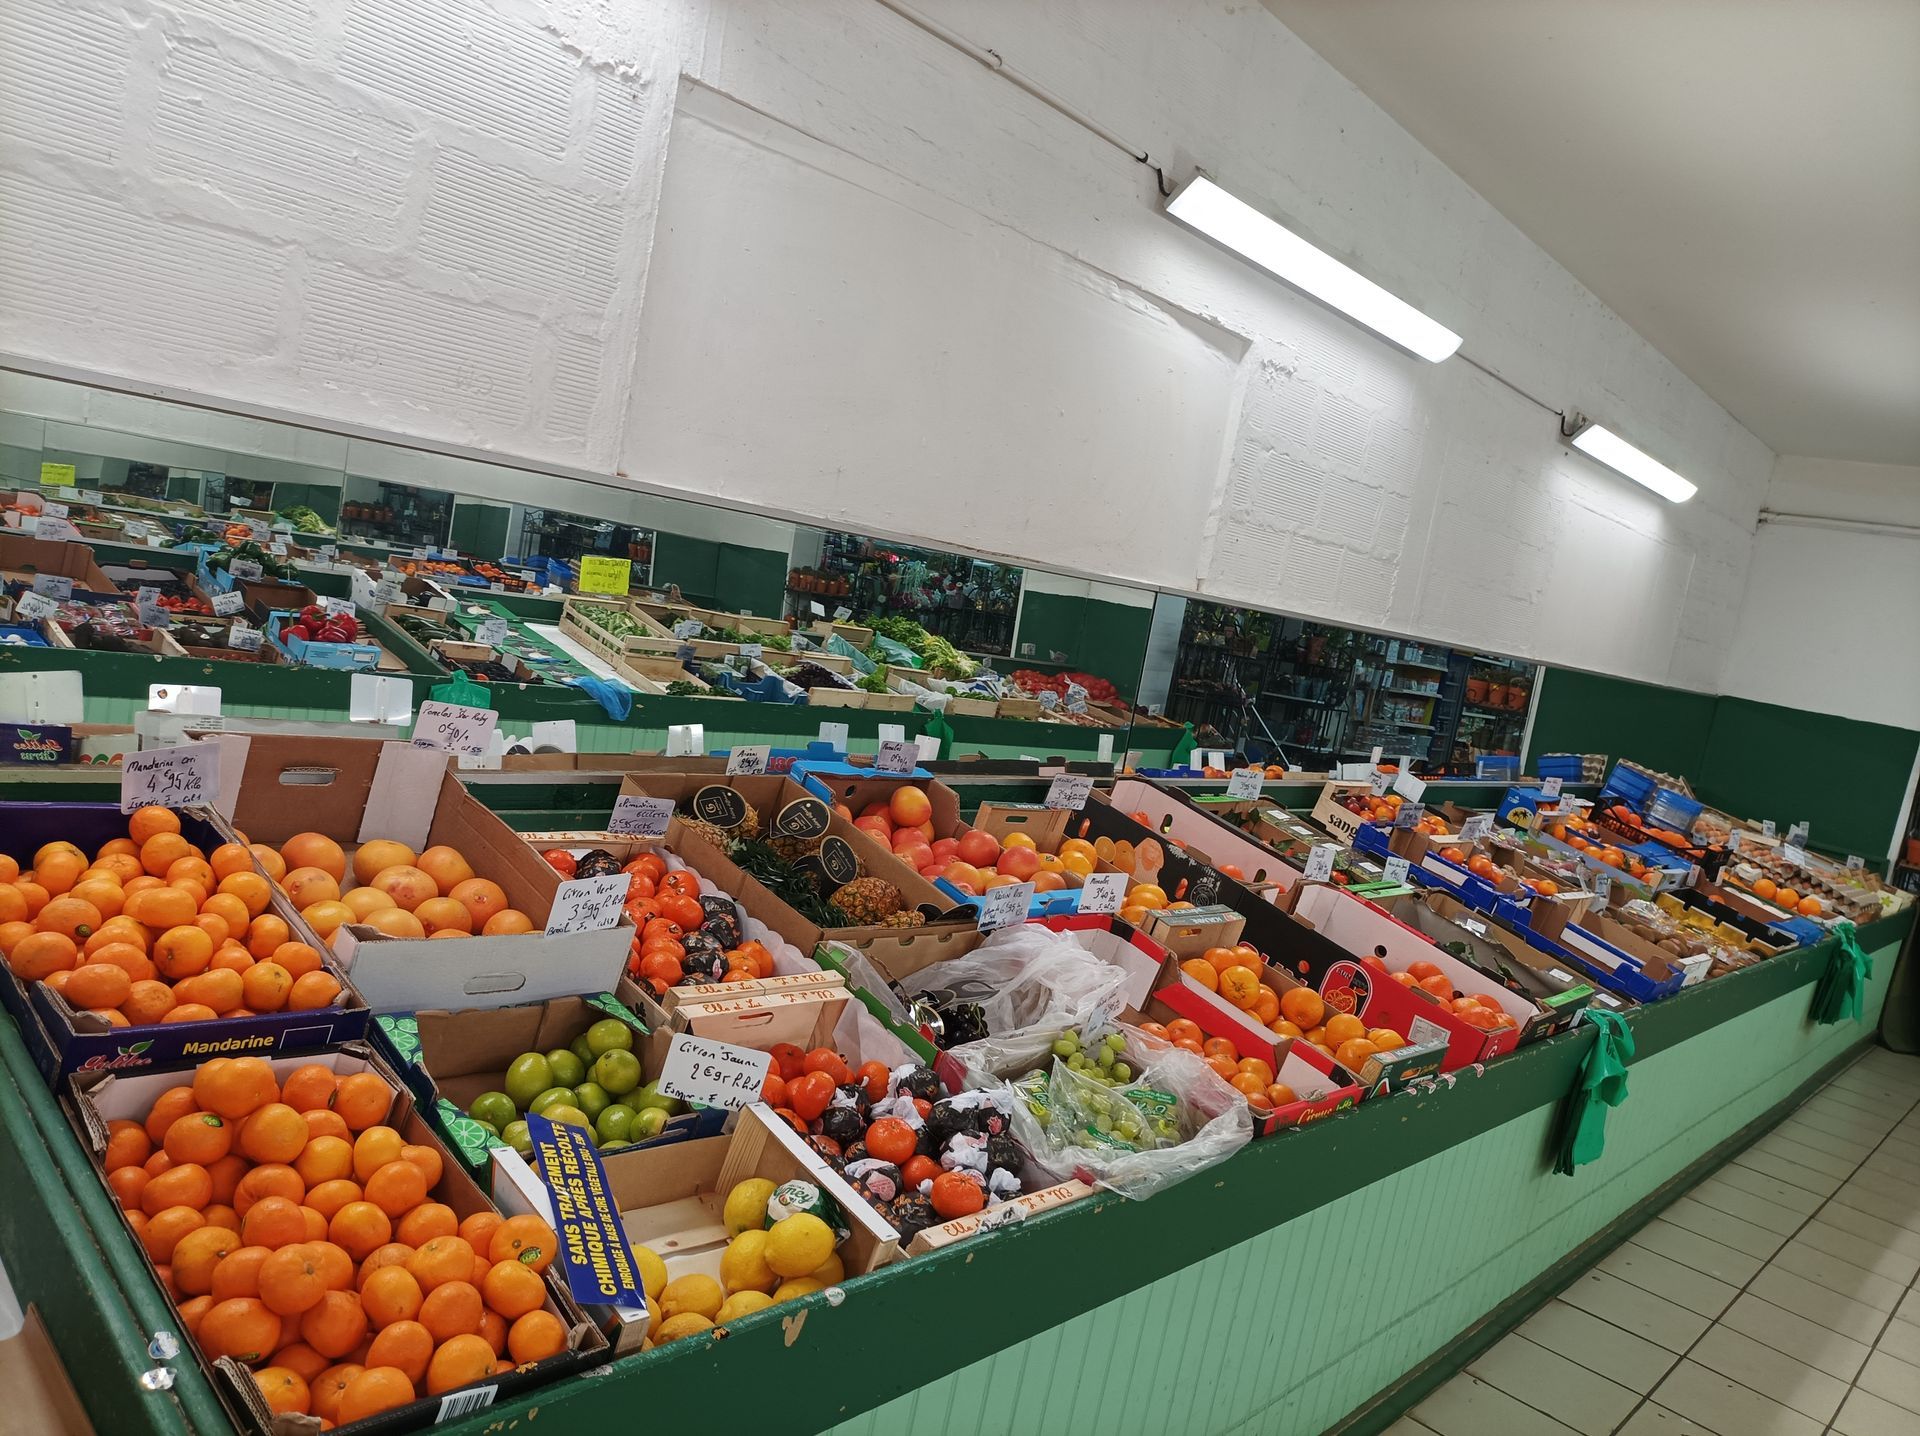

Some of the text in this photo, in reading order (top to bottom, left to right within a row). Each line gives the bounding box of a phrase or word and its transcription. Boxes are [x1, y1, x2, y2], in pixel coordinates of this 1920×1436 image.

[127, 757, 173, 773] Mandarine
[702, 1004, 731, 1013] Elle
[182, 1035, 274, 1055] Mandarine
[679, 1041, 759, 1068] Citron Jaune
[584, 1160, 604, 1195] VÉGÉTALE
[540, 1142, 588, 1265] SANS TRAITEMENT
[552, 1123, 617, 1295] CHIMIQUE APRÈS RÉCOLTE
[594, 1196, 609, 1213] CIRE
[599, 1213, 613, 1223] DE
[603, 1223, 619, 1241] BASE
[611, 1249, 635, 1290] ENROBAGE
